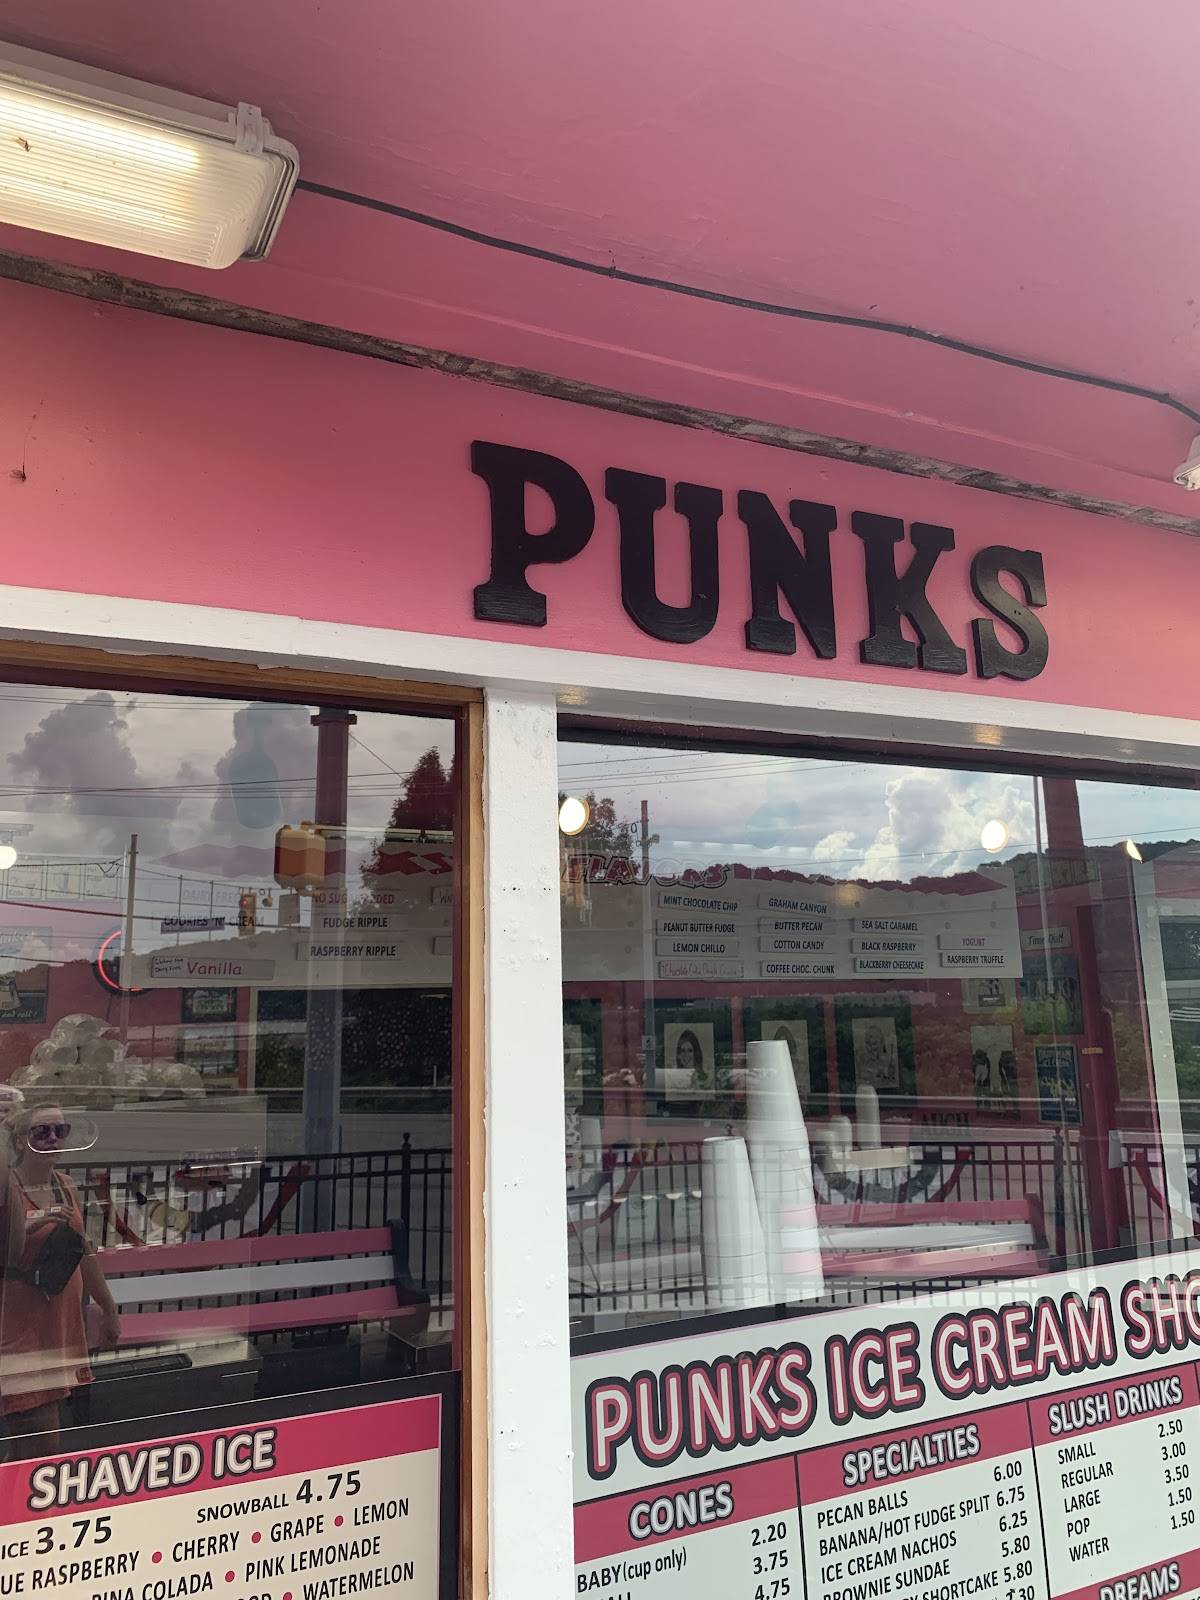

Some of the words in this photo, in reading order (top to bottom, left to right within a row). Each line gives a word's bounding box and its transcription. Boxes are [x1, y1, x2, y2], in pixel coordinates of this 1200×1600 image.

[471, 440, 1049, 681] PUNKS
[163, 913, 209, 927] COOKIES
[323, 917, 355, 928] FUDGE
[357, 917, 388, 928] RIPPLE
[663, 895, 683, 906] MINT
[683, 896, 722, 910] CHOCOLATE
[722, 901, 738, 912] CHIP
[768, 898, 799, 910] GRAHAM
[800, 901, 827, 914] CANYON
[663, 922, 688, 933] PEANUT
[689, 922, 714, 933] BUTTER
[714, 922, 735, 933] FUDGE
[774, 921, 801, 931] BUTTER
[801, 922, 823, 931] PECAN
[774, 940, 801, 950] COTTON
[802, 940, 825, 950] CANDY
[861, 920, 874, 930] SEA
[874, 920, 889, 930] SALT
[891, 921, 918, 931] CARAMEL
[962, 938, 986, 947] YOGURT
[310, 945, 364, 957] RASPBERRY
[366, 945, 397, 957] RIPPLE
[673, 943, 698, 953] LEMON
[859, 959, 891, 969] BLACKBERRY
[892, 960, 924, 970] CHEESECAKE
[861, 941, 881, 951] BLACK
[882, 941, 916, 951] RASPBERRY
[947, 954, 980, 963] RASPBERRY
[980, 954, 1004, 964] TRUFFLE
[187, 961, 242, 975] Vanilla
[766, 964, 792, 974] COFFEE
[792, 964, 812, 974] CHOC.
[813, 964, 835, 974] CHUNK
[585, 1342, 817, 1480] PUNKS
[824, 1321, 926, 1426] ICE
[931, 1287, 1117, 1400] CREAM
[1048, 1391, 1111, 1435] SLUSH
[1114, 1376, 1183, 1419] DRINKS
[842, 1423, 981, 1487] SPECIALTIES
[1058, 1442, 1096, 1465] SMALL
[1158, 1418, 1183, 1438] 2.50
[28, 1443, 204, 1511] SHAVED
[211, 1427, 278, 1480] ICE
[1061, 1461, 1114, 1489] REGULAR
[1161, 1441, 1186, 1461] 3.00
[817, 1508, 864, 1529] PECAN
[868, 1490, 908, 1515] BALLS
[993, 1460, 1022, 1482] 6.00
[1064, 1489, 1101, 1513] LARGE
[1164, 1464, 1189, 1484] 3.50
[1, 1541, 30, 1560] ICE
[35, 1516, 112, 1554] 3.75
[196, 1493, 289, 1524] SNOWBALL
[295, 1470, 361, 1504] 4.75
[628, 1481, 735, 1541] CONES
[819, 1517, 911, 1557] BANANA/HOT
[914, 1504, 956, 1530] FUDGE
[959, 1494, 990, 1518] SPLIT
[996, 1485, 1025, 1507] 6.75
[1067, 1517, 1090, 1537] POP
[1167, 1486, 1192, 1507] 1.50
[32, 1550, 140, 1590] RASPBERRY
[172, 1531, 240, 1563] CHERRY
[270, 1515, 324, 1543] GRAPE
[353, 1498, 410, 1526] LEMON
[655, 1546, 687, 1571] only)
[751, 1521, 787, 1547] 2.20
[821, 1562, 844, 1584] ICE
[847, 1548, 897, 1576] CREAM
[901, 1530, 957, 1560] NACHOS
[999, 1510, 1028, 1532] 6.25
[1069, 1537, 1110, 1562] WATER
[1170, 1509, 1195, 1530] 1.50
[142, 1571, 214, 1600] COLADA
[245, 1556, 285, 1582] PINK
[291, 1536, 381, 1572] LEMONADE
[303, 1561, 415, 1600] WATERMELON
[752, 1549, 789, 1575] 3.75
[895, 1559, 951, 1590] SUNDAE
[1001, 1535, 1030, 1558] 5.80
[922, 1570, 999, 1600] SHORTCAKE
[1003, 1560, 1033, 1583] 5.80
[1100, 1561, 1181, 1600] DREAMS
[754, 1577, 790, 1600] 4.75
